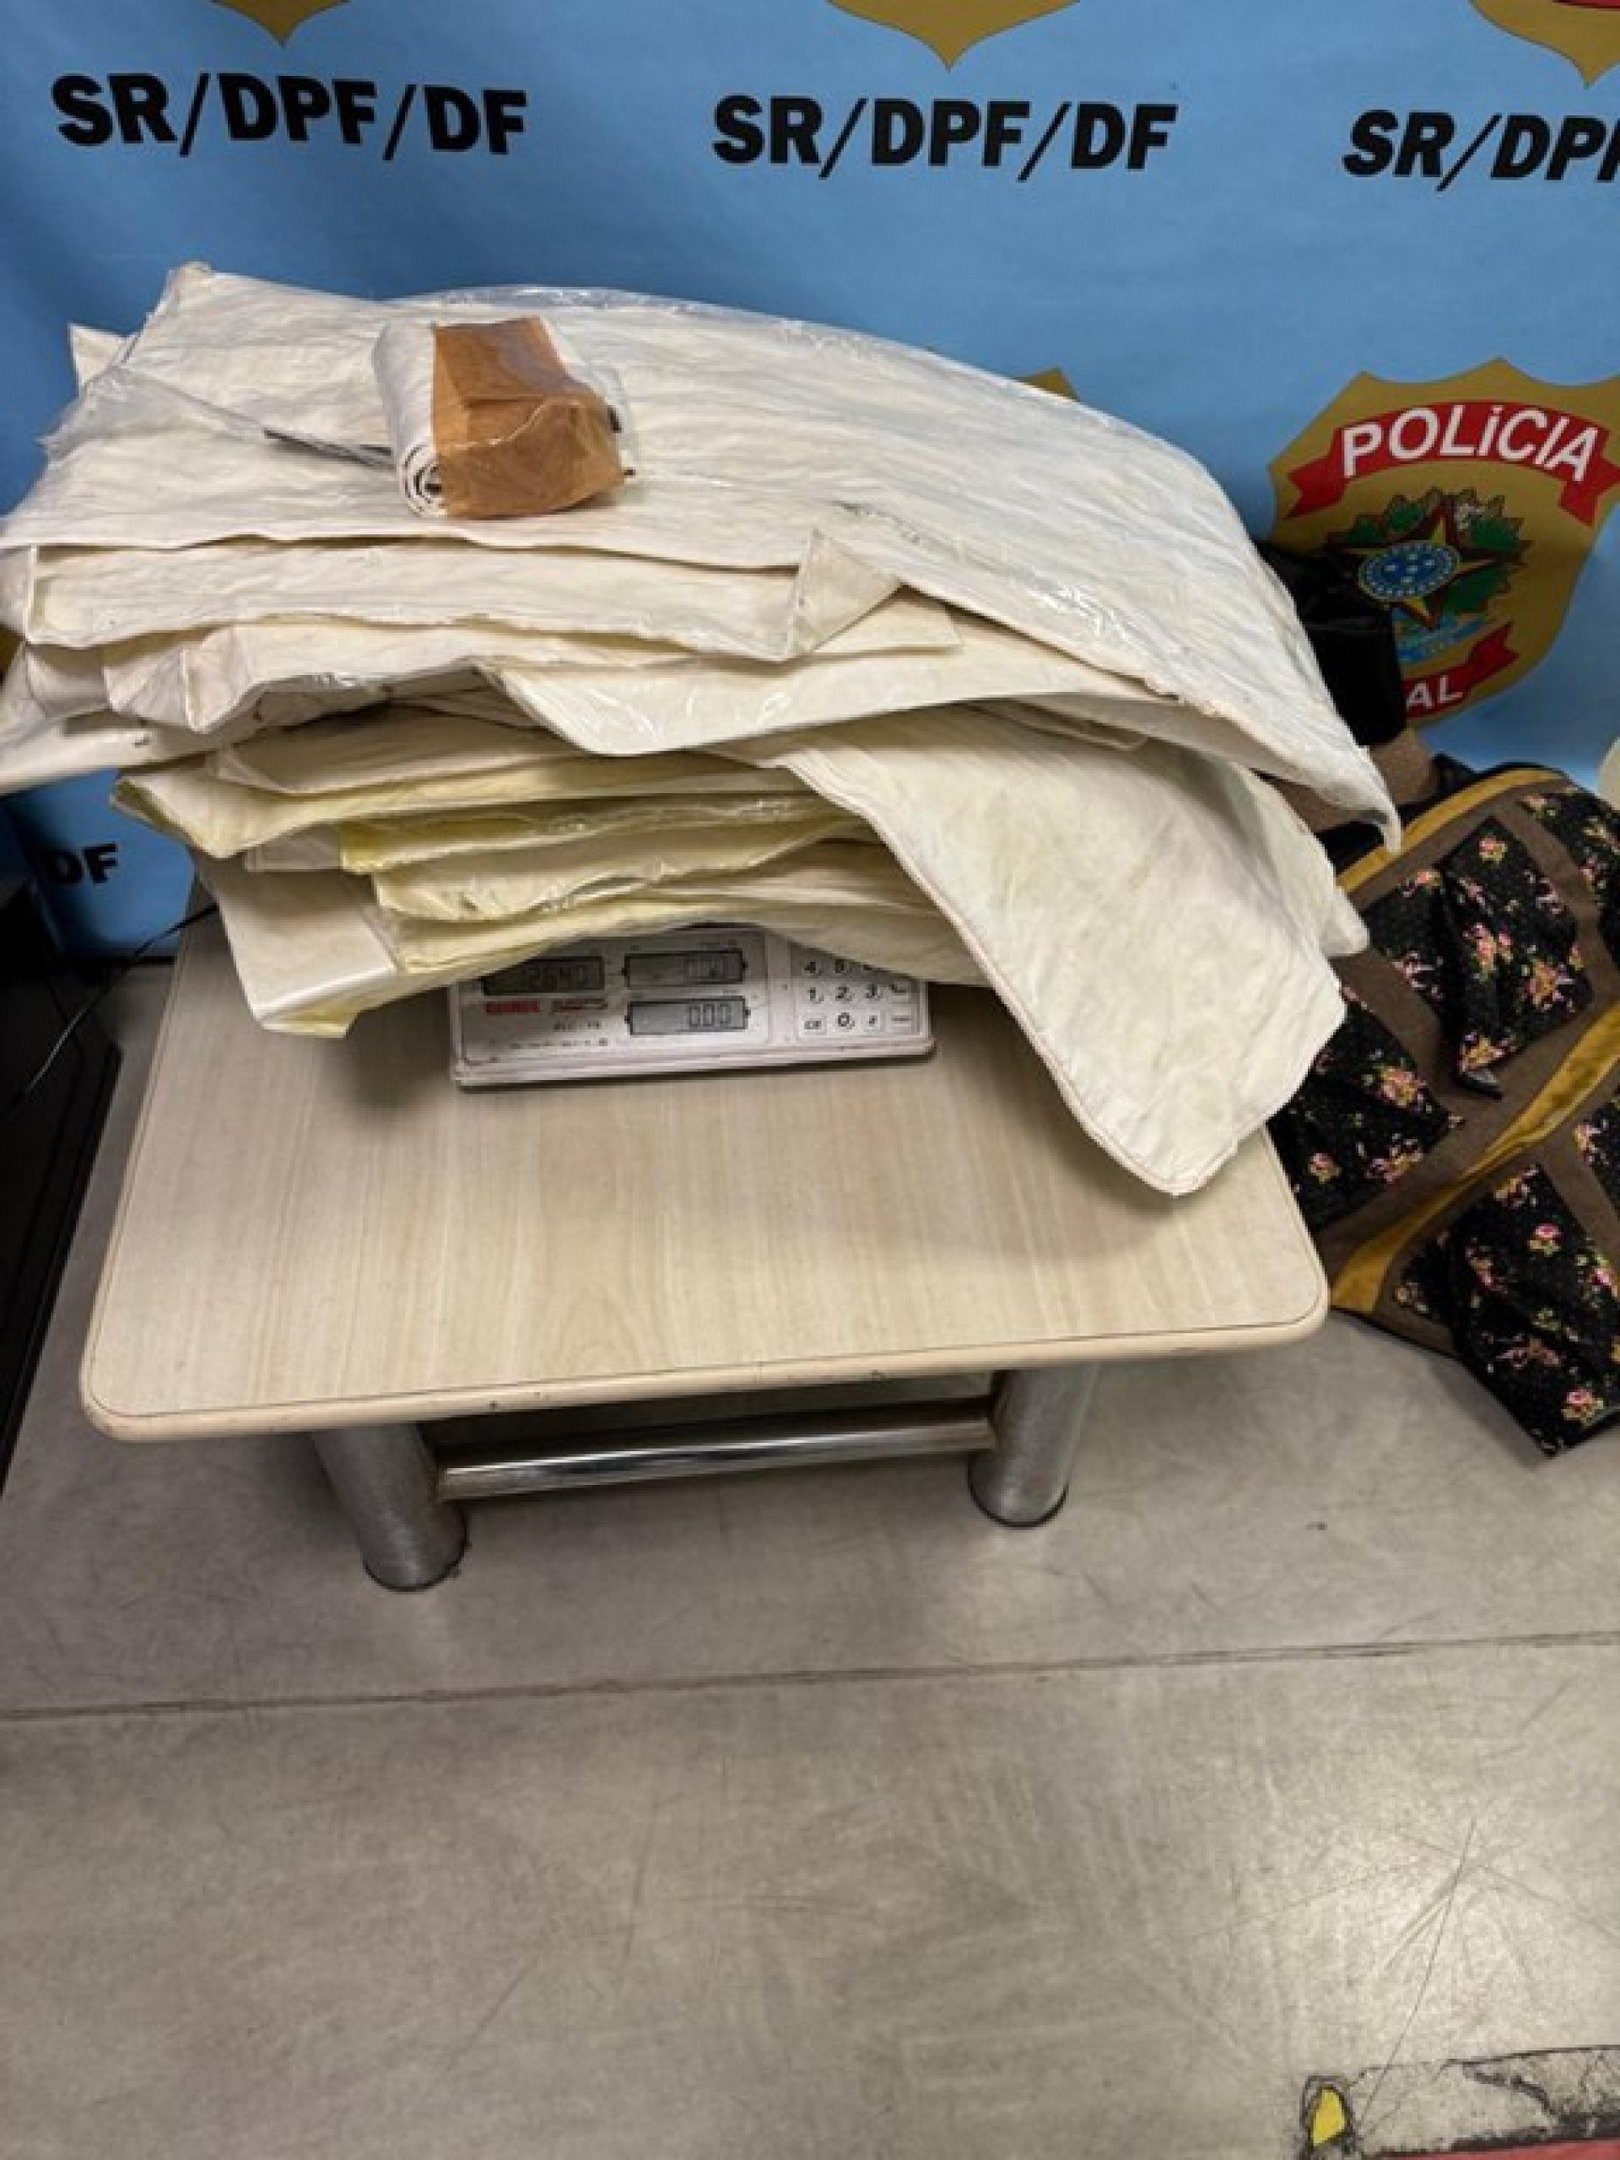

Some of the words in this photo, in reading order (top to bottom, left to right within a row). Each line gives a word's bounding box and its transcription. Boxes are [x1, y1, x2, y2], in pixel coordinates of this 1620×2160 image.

[51, 73, 528, 160] SR/DPF/DF
[713, 94, 1179, 182] SR/DPF/DF
[1405, 674, 1464, 709] AL
